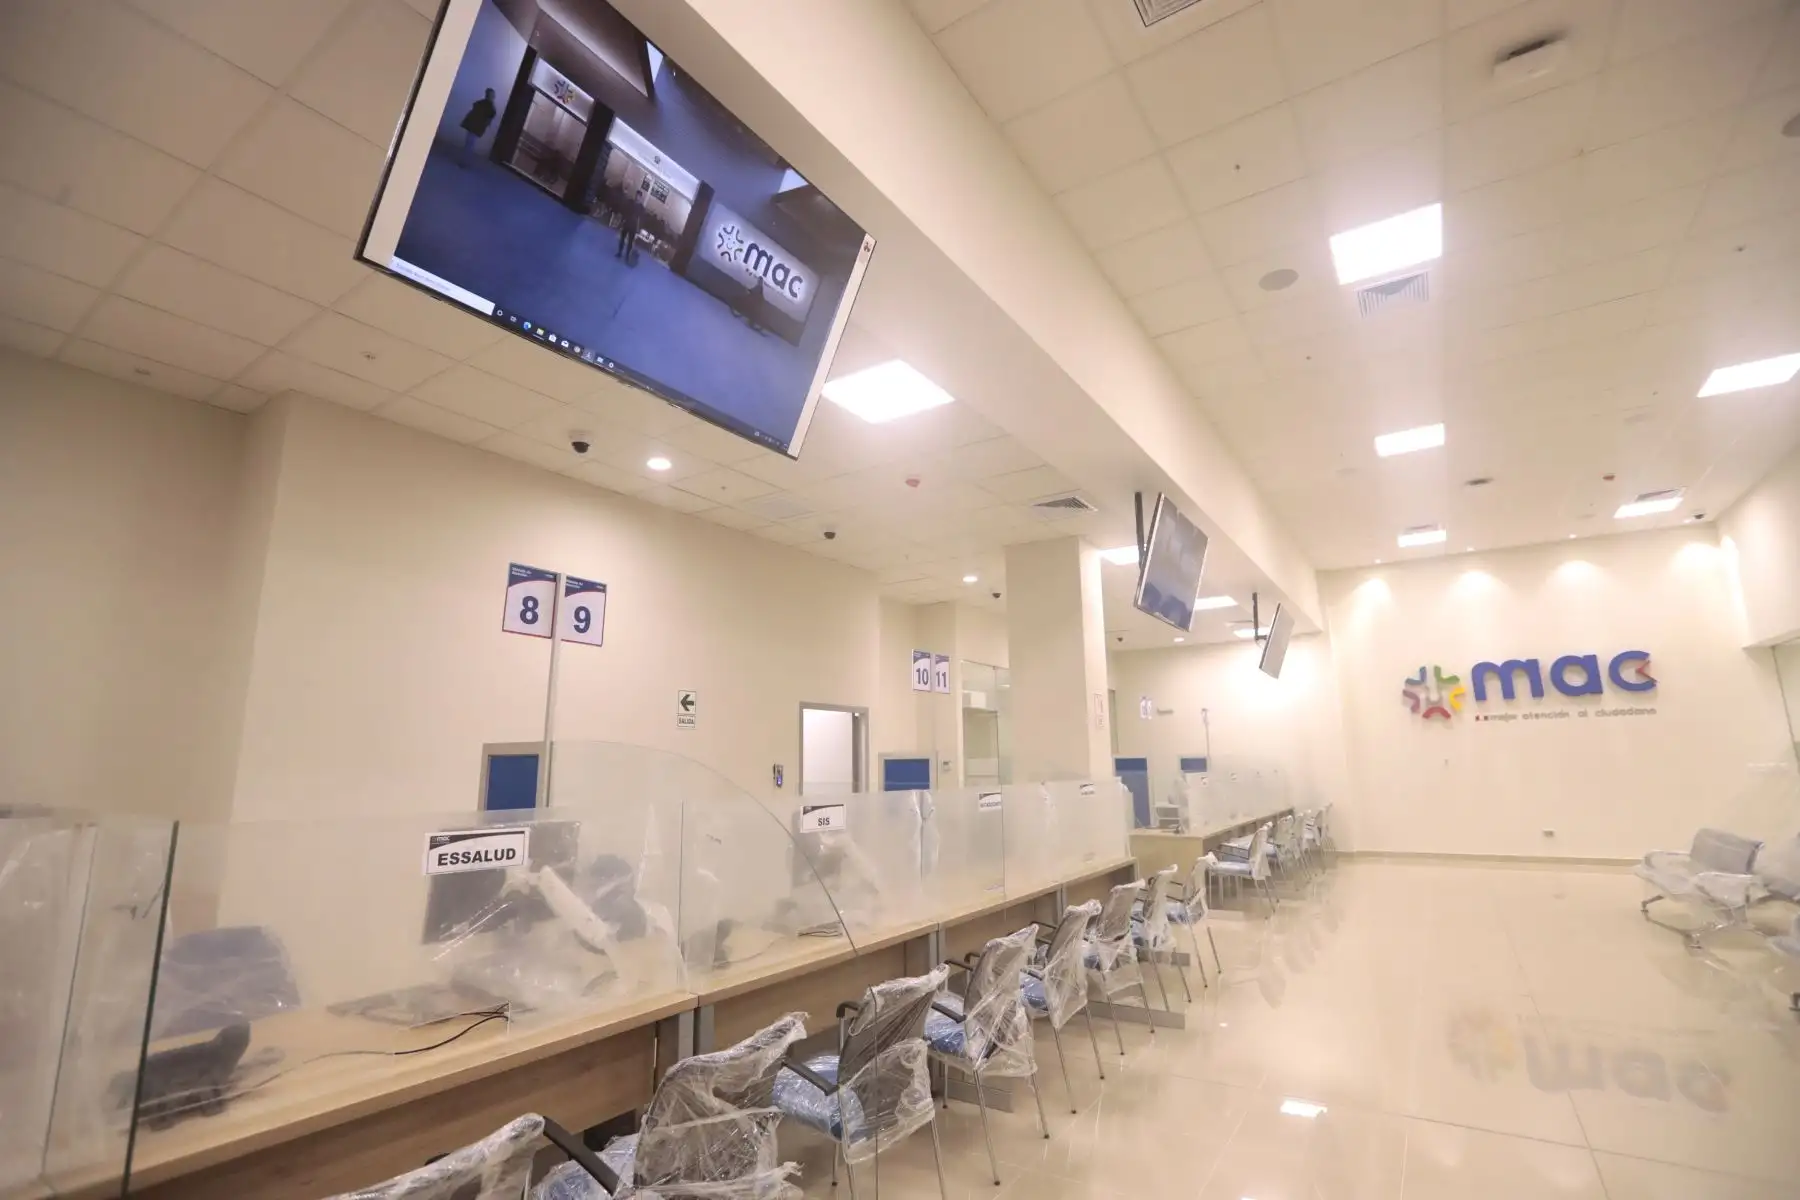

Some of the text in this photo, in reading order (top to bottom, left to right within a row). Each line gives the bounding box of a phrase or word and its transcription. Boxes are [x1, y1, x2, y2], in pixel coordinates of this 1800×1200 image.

[743, 243, 803, 298] mac
[520, 596, 539, 624] 8
[573, 606, 591, 633] 9
[916, 668, 929, 685] 10
[936, 671, 947, 688] 11
[1471, 650, 1658, 701] mac
[1577, 708, 1588, 718] al
[1595, 705, 1658, 717] ciudadano
[817, 817, 830, 826] SIS
[437, 848, 516, 866] ESSALUD
